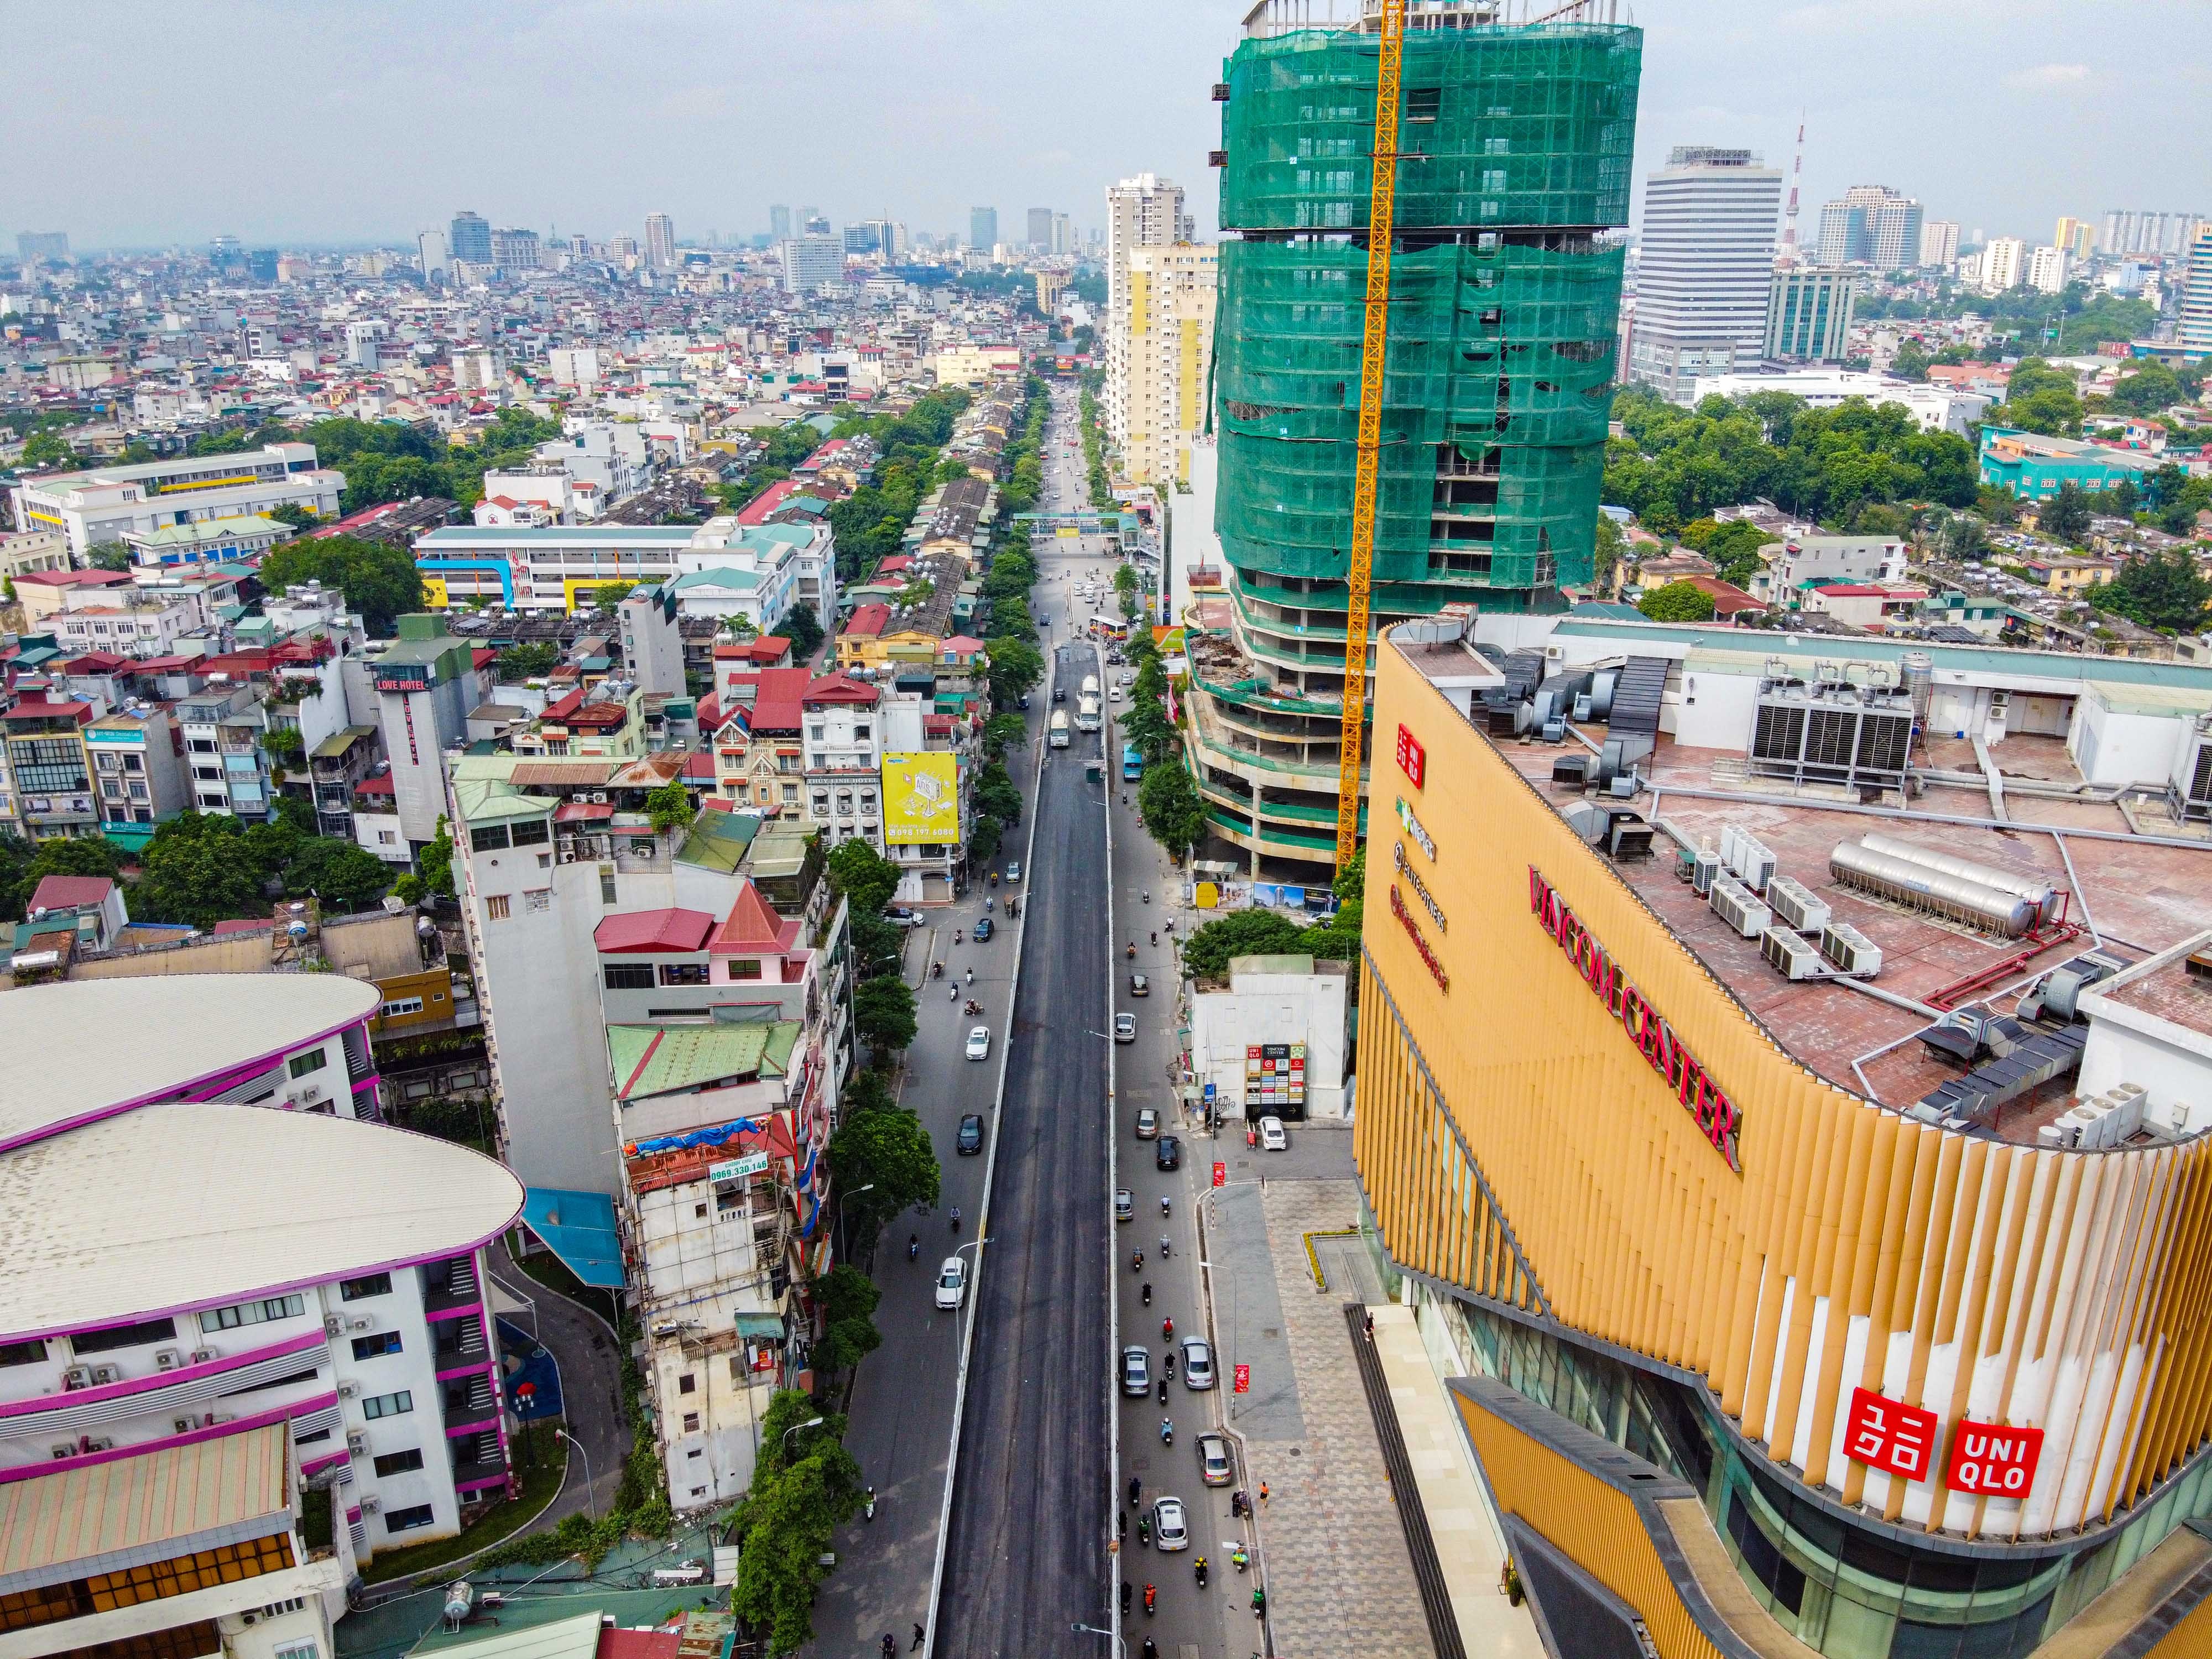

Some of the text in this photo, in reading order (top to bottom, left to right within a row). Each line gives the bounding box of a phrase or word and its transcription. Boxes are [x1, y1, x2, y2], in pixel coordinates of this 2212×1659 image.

[377, 681, 425, 690] LOVE HOTEL
[1410, 743, 1418, 765] UNI
[1408, 760, 1418, 782] QLO
[1404, 863, 1444, 932] ELITE FITNESS
[1528, 864, 1743, 1173] VINCOM CENTER
[711, 1160, 767, 1181] 0969.330.146
[1861, 1404, 1924, 1445] ユニ
[1854, 1431, 1920, 1472] クロ
[1965, 1434, 2026, 1462] UNI
[1959, 1462, 2025, 1490] QLO
